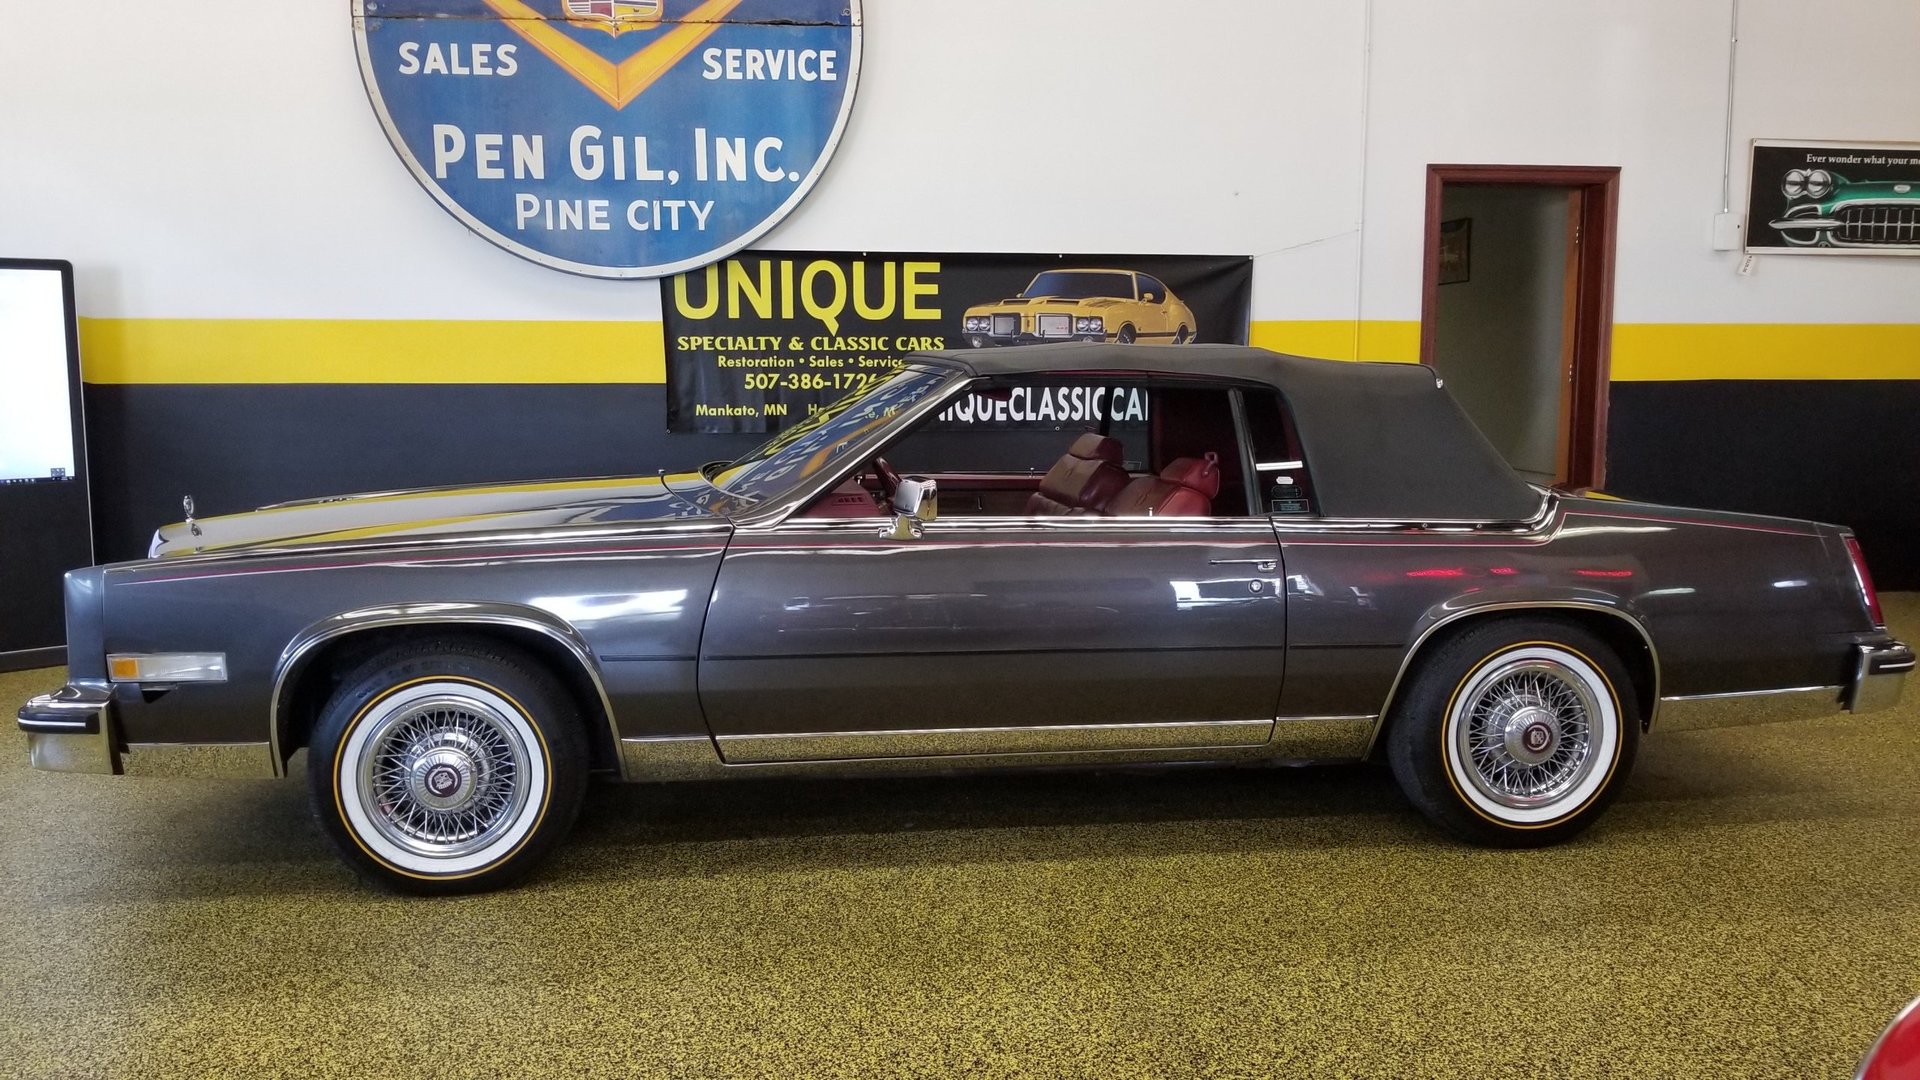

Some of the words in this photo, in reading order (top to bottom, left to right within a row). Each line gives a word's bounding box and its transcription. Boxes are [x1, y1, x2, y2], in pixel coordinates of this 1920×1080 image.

[398, 41, 519, 77] SALES
[702, 47, 838, 81] SERVICE
[1806, 153, 1827, 163] Ever
[1828, 154, 1862, 164] wonder
[1864, 155, 1885, 165] what
[1886, 157, 1909, 168] your
[674, 259, 942, 337] UNIQUE
[677, 336, 783, 352] SPECIALTY
[788, 337, 805, 351] &
[810, 336, 889, 351] CLASSIC
[895, 336, 946, 351] CARS
[717, 355, 795, 368] Restoration
[809, 355, 845, 368] Sales
[695, 404, 760, 417] Mankato,
[763, 404, 788, 416] MN
